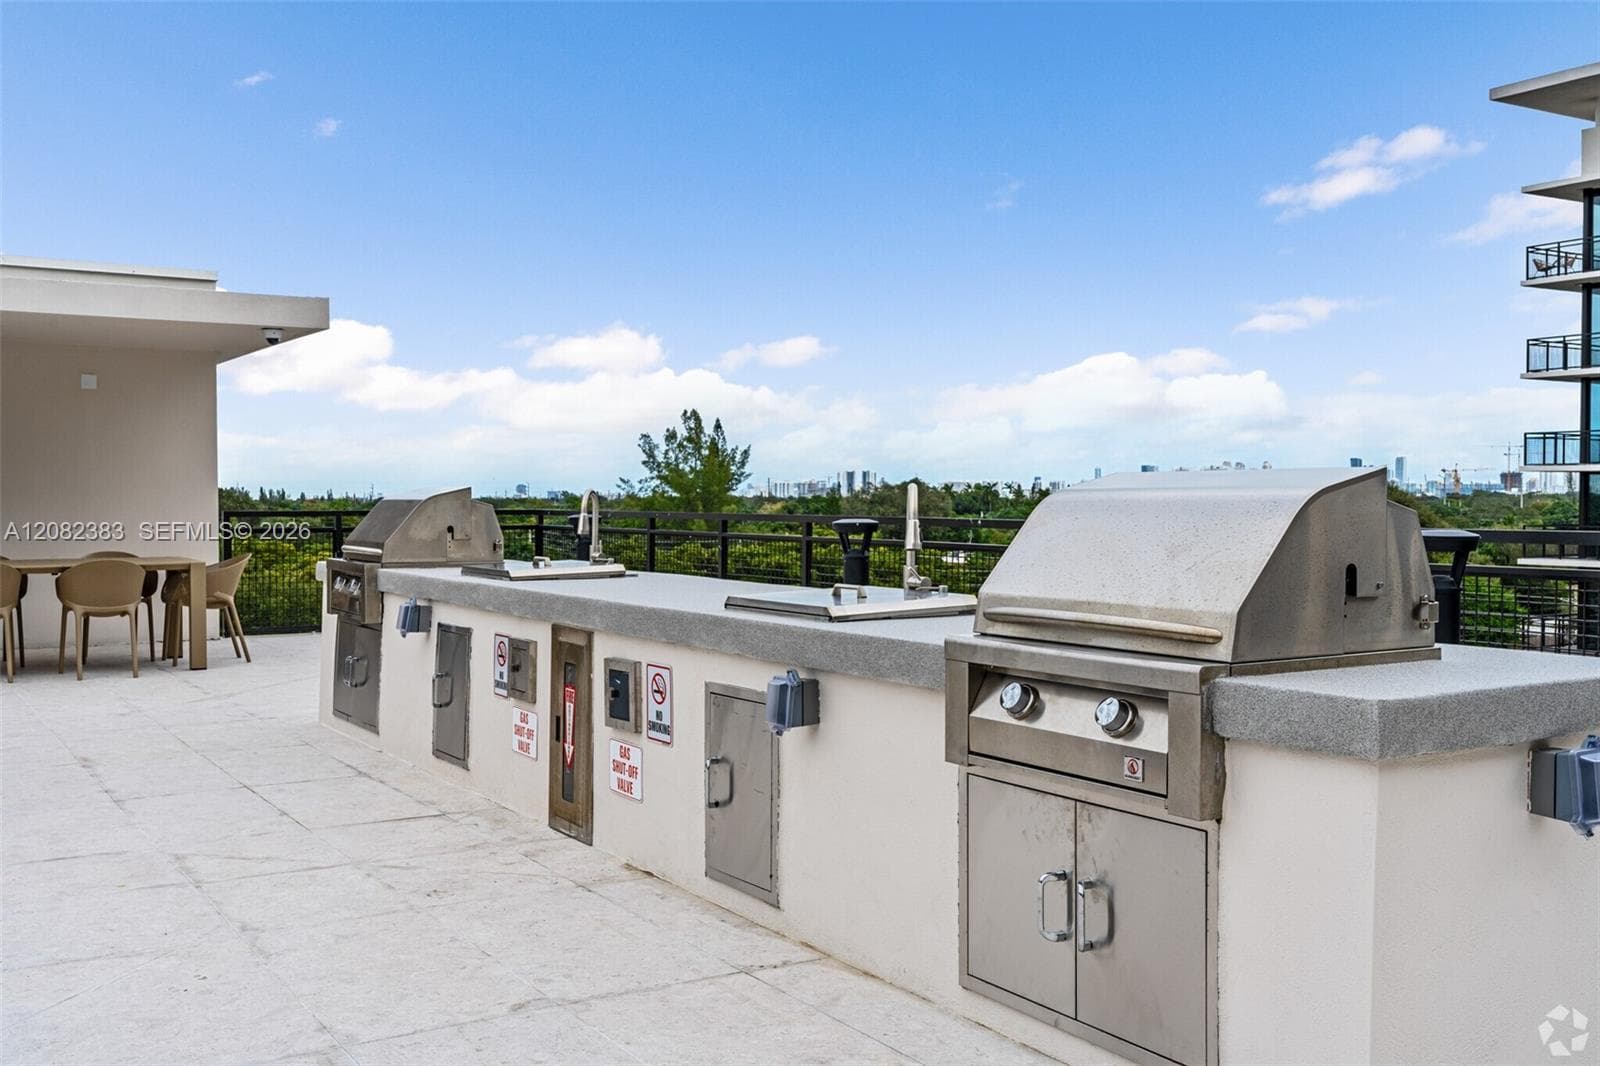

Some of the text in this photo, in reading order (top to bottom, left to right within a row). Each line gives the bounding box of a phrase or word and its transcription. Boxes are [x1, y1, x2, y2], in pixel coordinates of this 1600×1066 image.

[520, 712, 528, 725] GAS
[655, 710, 663, 721] NO
[514, 724, 534, 741] SHUT-OFF
[648, 721, 670, 736] SMOKING
[518, 741, 530, 754] VALVE
[619, 745, 630, 760] GAS
[612, 759, 638, 779] SHUT-OFF
[617, 776, 633, 795] VALVE
